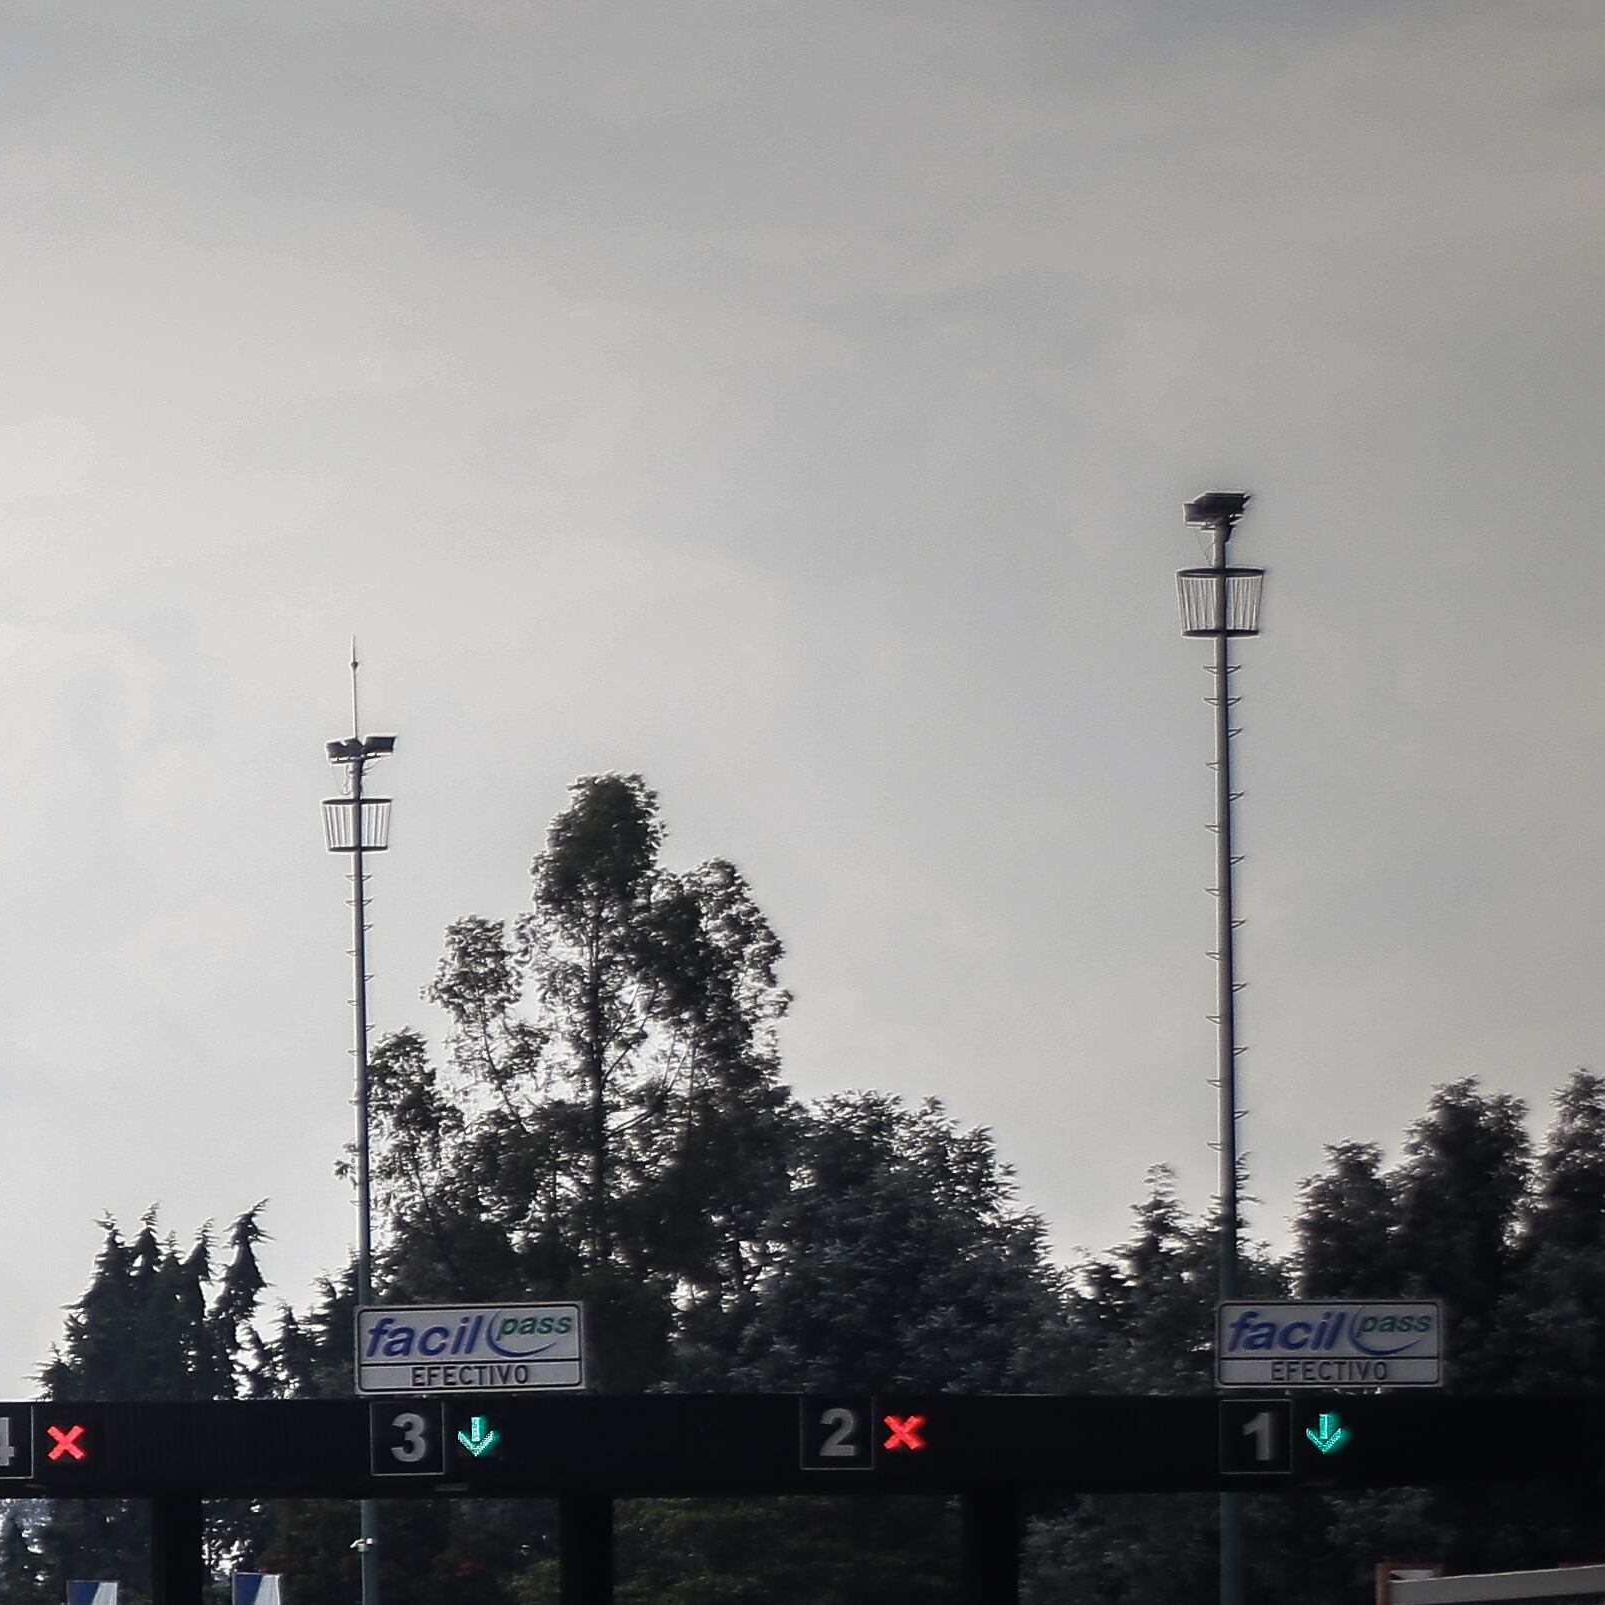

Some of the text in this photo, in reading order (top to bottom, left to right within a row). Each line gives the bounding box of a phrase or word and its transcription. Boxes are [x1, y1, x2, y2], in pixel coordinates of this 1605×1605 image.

[366, 1314, 574, 1358] facil pass
[1228, 1311, 1433, 1352] facil pass
[410, 1364, 530, 1387] EFECTIVO
[1270, 1361, 1388, 1381] EFECTIVO
[391, 1412, 427, 1463] 3
[819, 1408, 855, 1457] 2
[1242, 1412, 1272, 1461] 1
